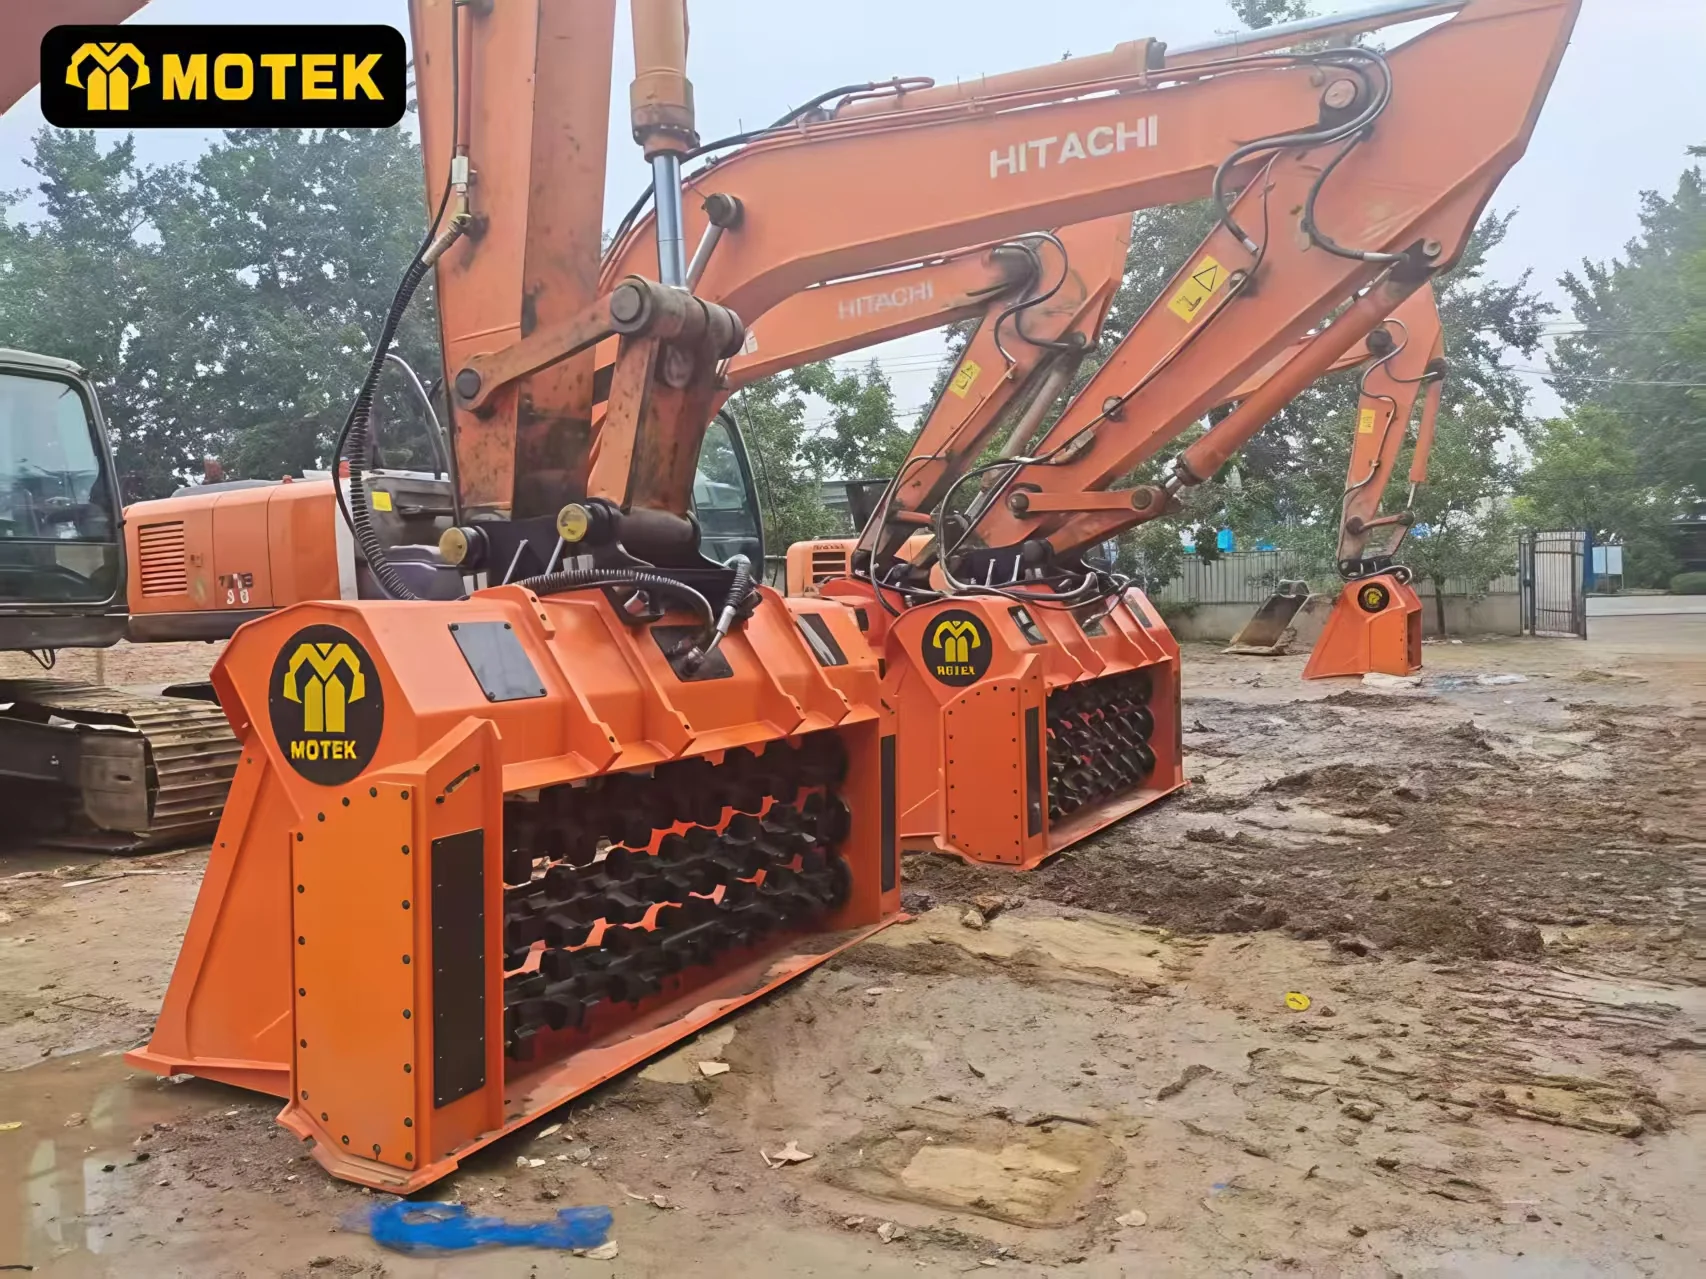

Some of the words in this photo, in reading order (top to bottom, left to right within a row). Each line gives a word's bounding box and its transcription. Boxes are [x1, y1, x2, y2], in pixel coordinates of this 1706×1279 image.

[989, 114, 1159, 179] HITACHI
[837, 280, 934, 320] HITACHI
[290, 739, 357, 761] MOTEK
